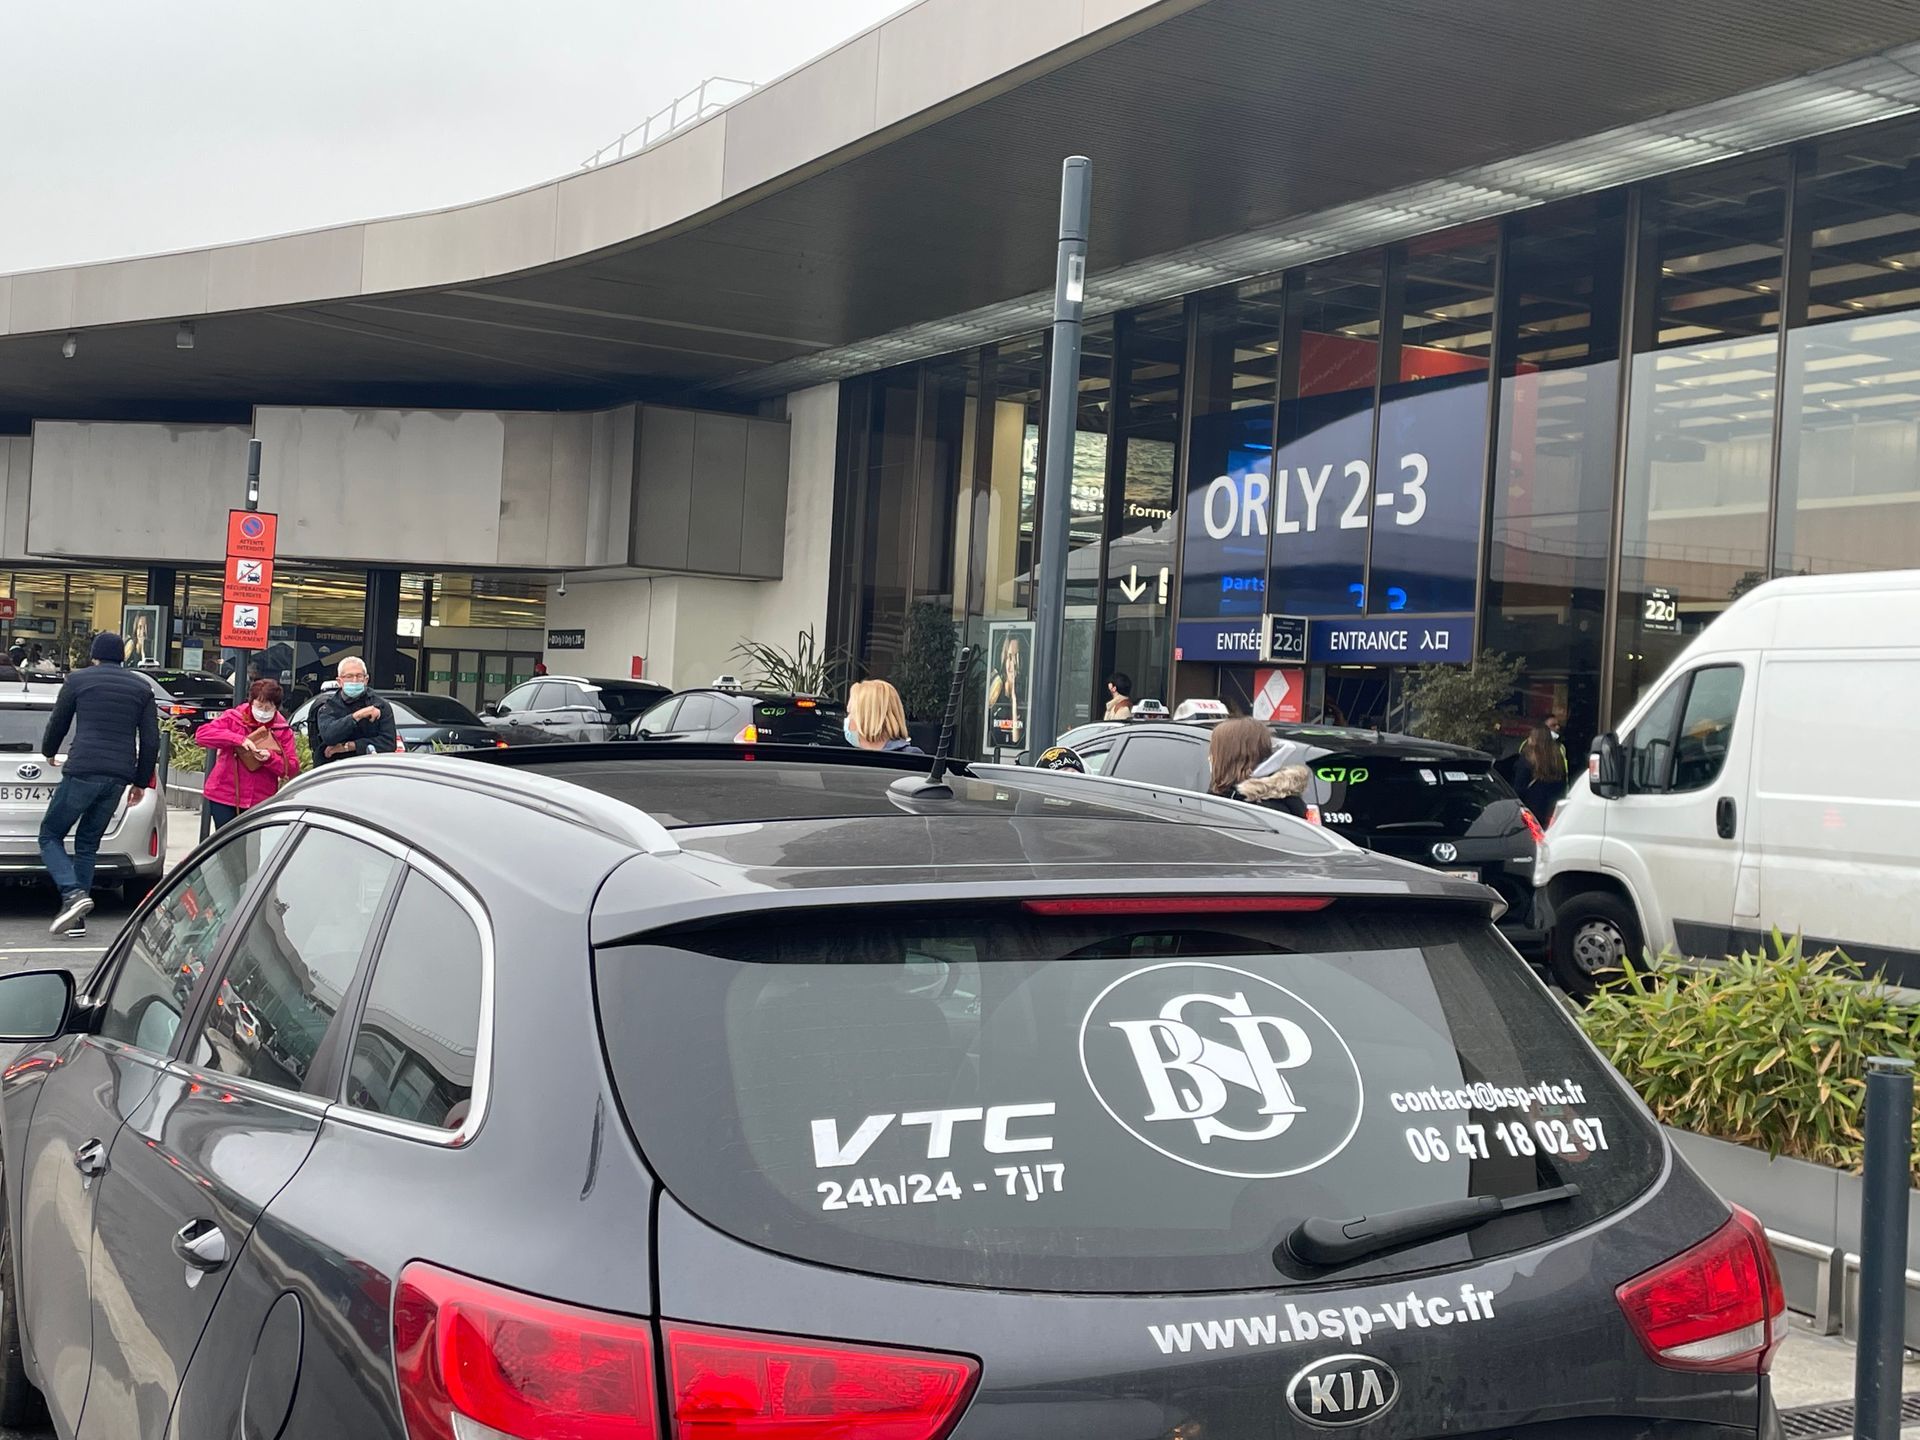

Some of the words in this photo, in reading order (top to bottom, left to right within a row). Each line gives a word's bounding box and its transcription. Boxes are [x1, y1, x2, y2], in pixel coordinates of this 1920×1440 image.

[1203, 463, 1334, 540] ORLY
[1340, 452, 1429, 529] 2-3
[1644, 600, 1676, 622] 22d
[1217, 628, 1264, 650] ENTRÉE
[1330, 631, 1408, 650] ENTRANCE
[1273, 633, 1303, 652] 22d
[1419, 630, 1450, 650] 入口
[1196, 702, 1218, 710] TAXI
[1316, 768, 1347, 782] G7
[1324, 812, 1353, 824] 3390
[1390, 1078, 1587, 1113] contact@bsp-vtc.fr
[810, 1101, 1056, 1168] VTC
[1405, 1126, 1451, 1164] 06
[1455, 1123, 1490, 1159] 47
[1495, 1121, 1537, 1157] 18
[1534, 1119, 1577, 1155] 02
[1573, 1117, 1609, 1152] 97
[816, 1171, 963, 1211] 24h/24
[994, 1163, 1066, 1201] 7j/7
[1147, 1283, 1496, 1354] www.bsp-vtc.fr
[1307, 1368, 1386, 1415] KIA
